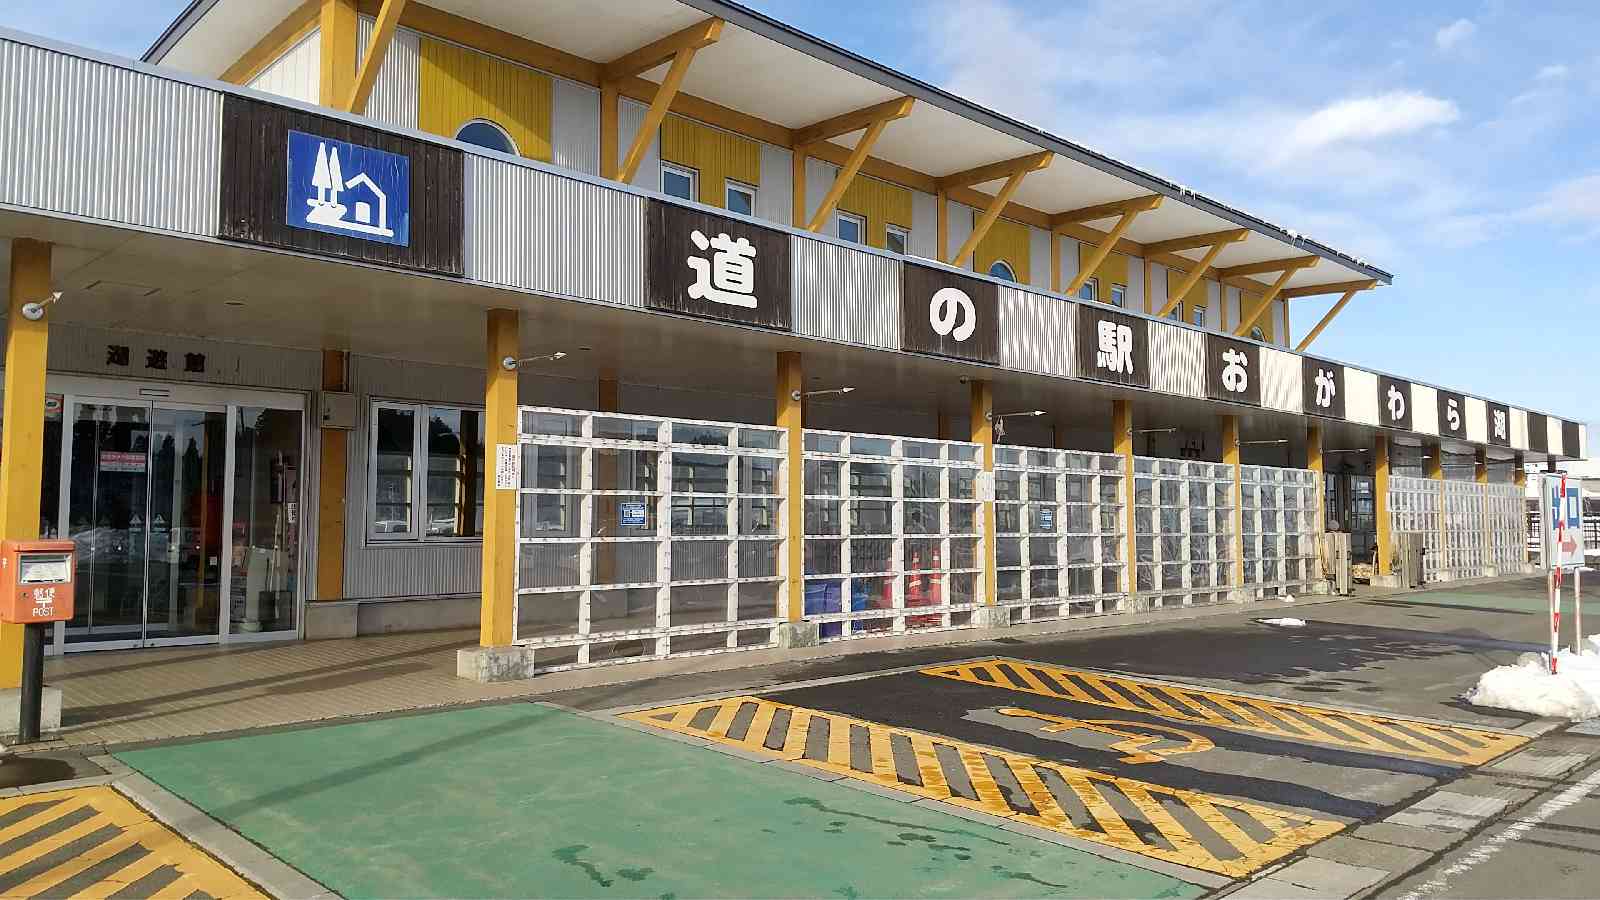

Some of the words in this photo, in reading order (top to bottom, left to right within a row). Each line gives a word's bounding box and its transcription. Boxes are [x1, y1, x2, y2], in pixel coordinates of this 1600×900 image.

[687, 229, 1506, 440] 道の駅おがわら湖
[32, 607, 54, 617] POST
